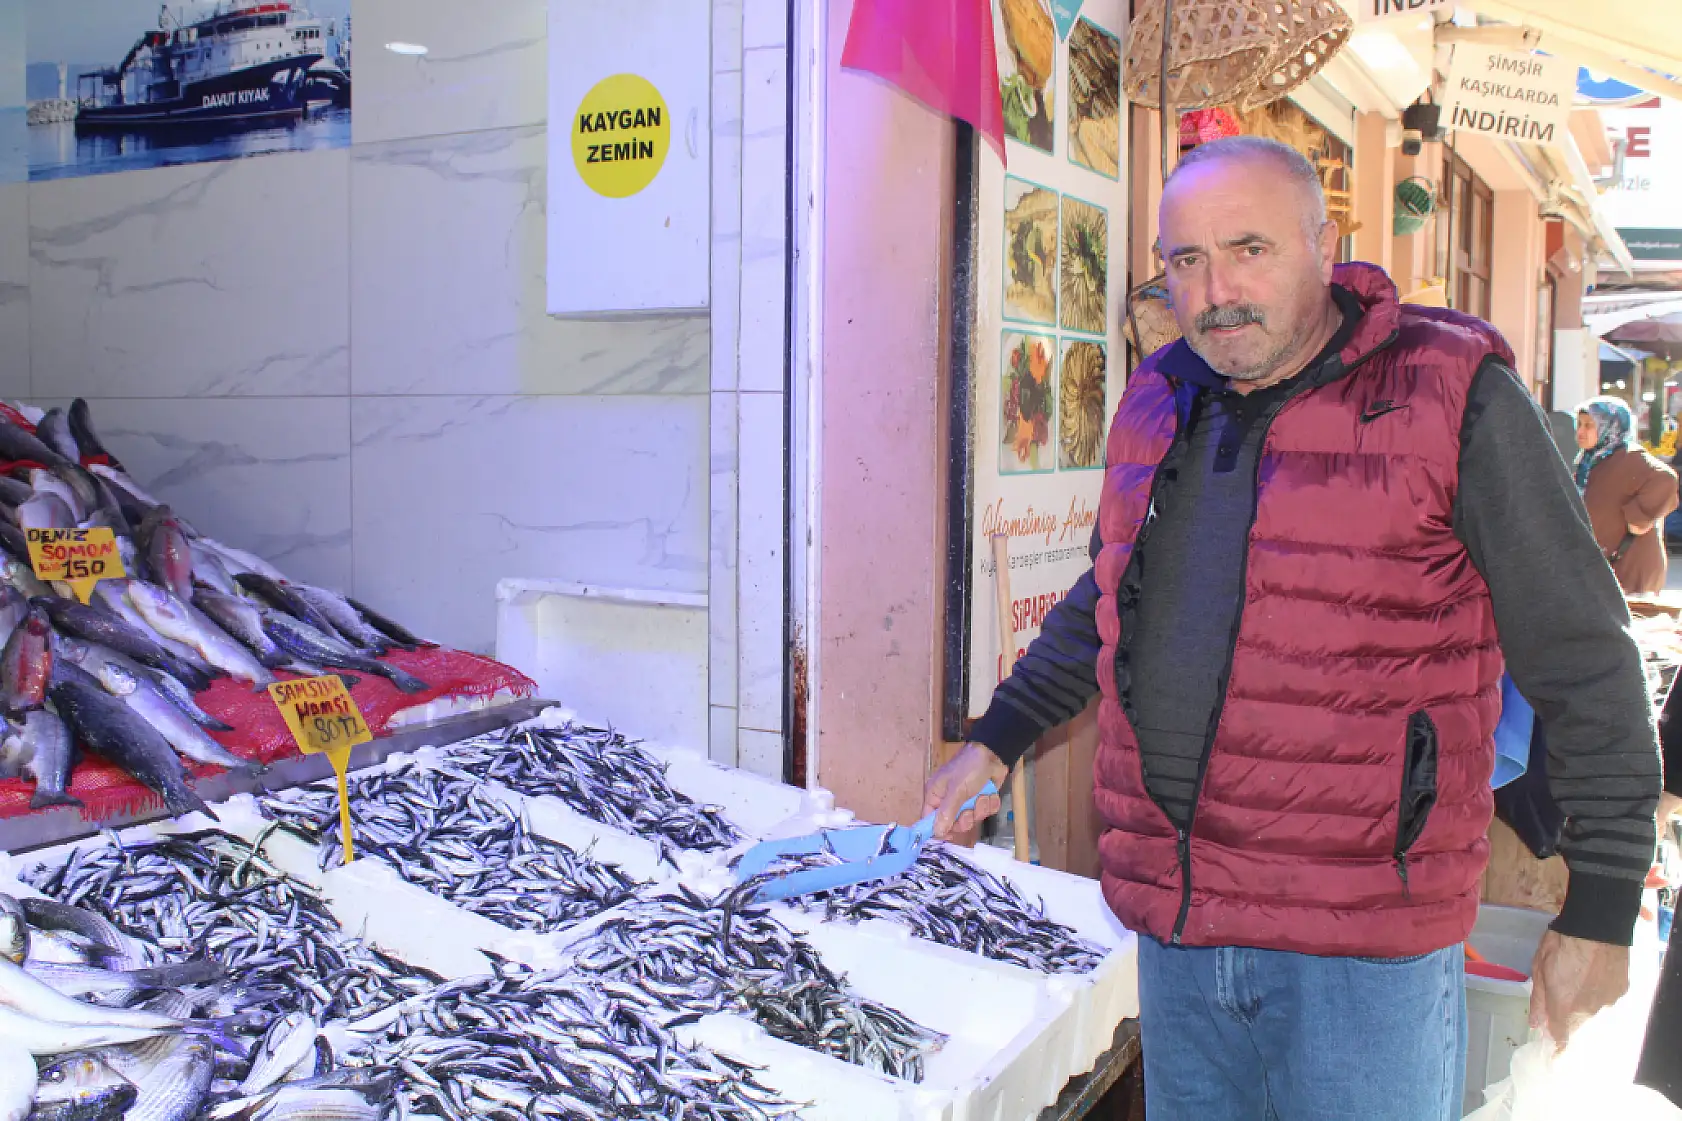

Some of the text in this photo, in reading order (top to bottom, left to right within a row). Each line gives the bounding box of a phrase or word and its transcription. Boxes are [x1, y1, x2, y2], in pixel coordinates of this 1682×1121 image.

[202, 91, 235, 108] DAVUT
[1460, 76, 1560, 107] KAŞIKLARDA
[579, 106, 661, 134] KAYGAN
[1451, 101, 1555, 142] İNDİRİM
[586, 136, 653, 164] ZEMİN
[40, 541, 114, 560] SOMON
[61, 560, 105, 579] 150
